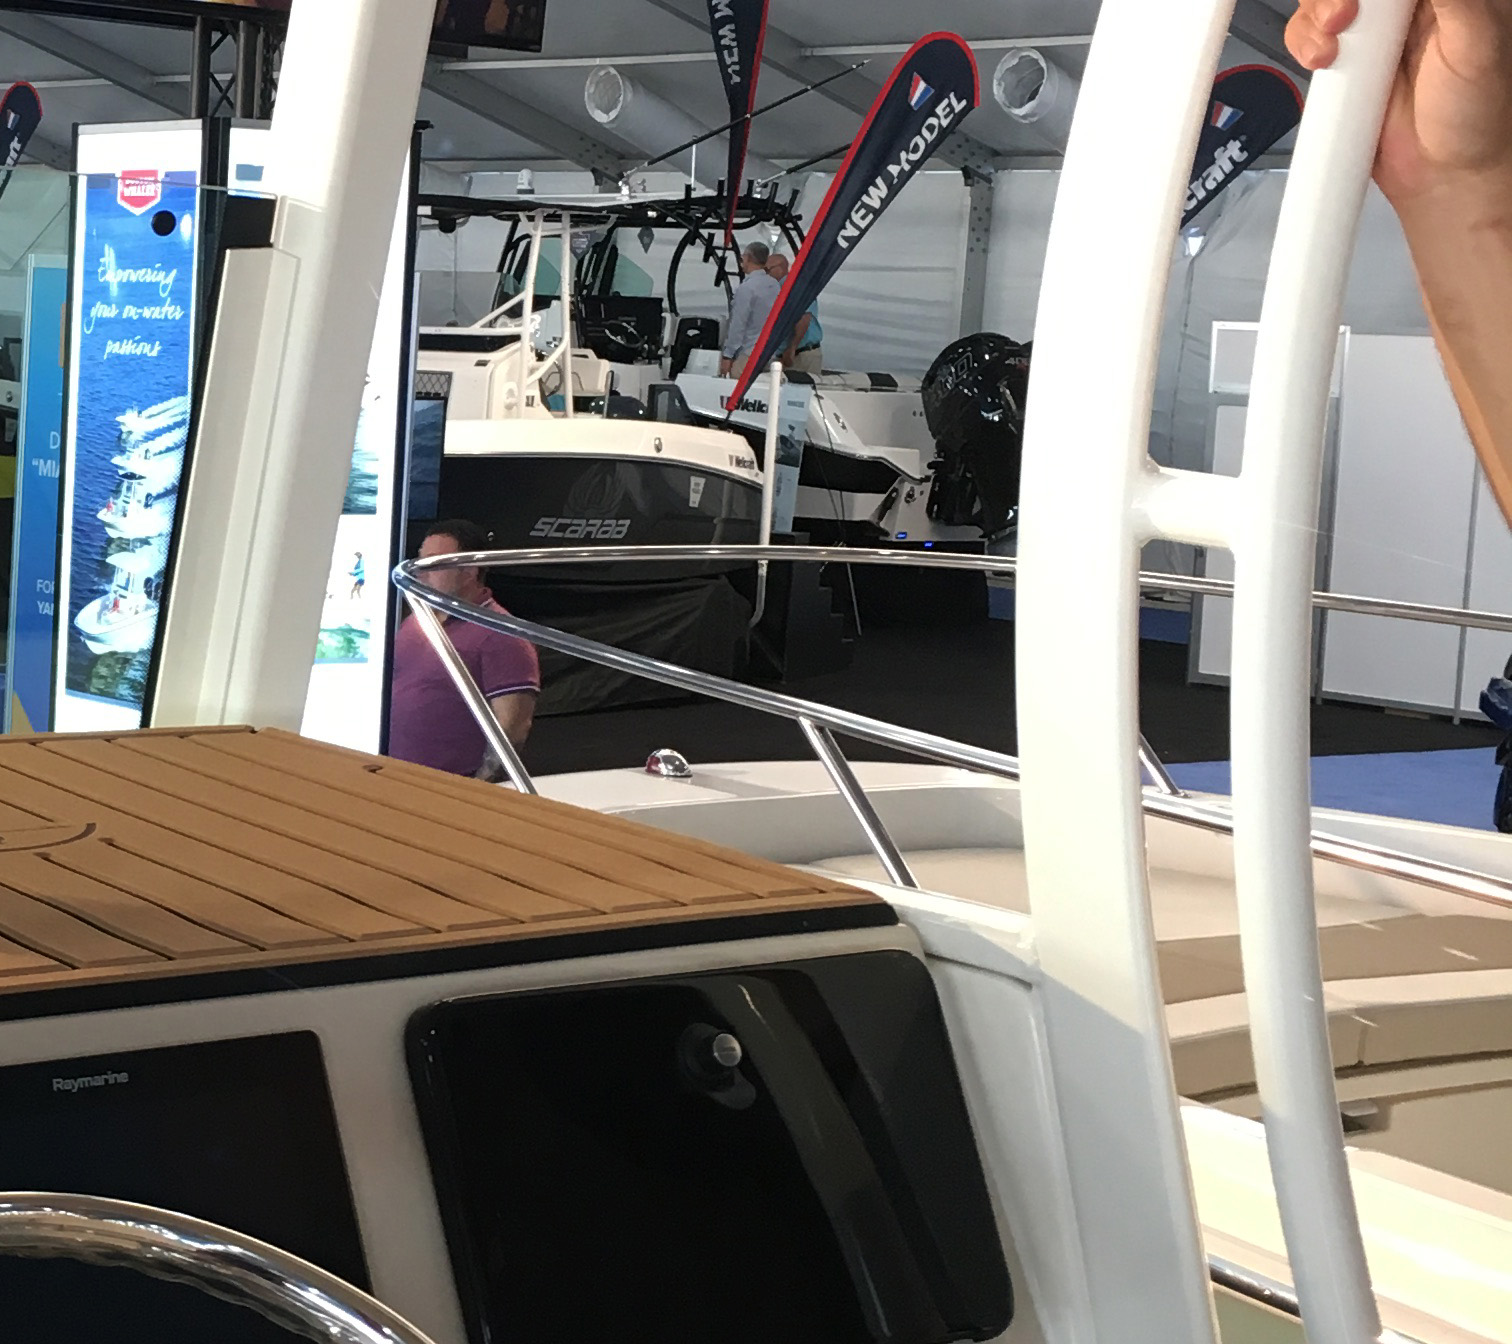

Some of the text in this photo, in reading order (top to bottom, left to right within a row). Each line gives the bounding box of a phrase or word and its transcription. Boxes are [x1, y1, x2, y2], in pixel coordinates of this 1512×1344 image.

[835, 92, 967, 250] NEW MODEL
[52, 1071, 129, 1093] Raymarine
